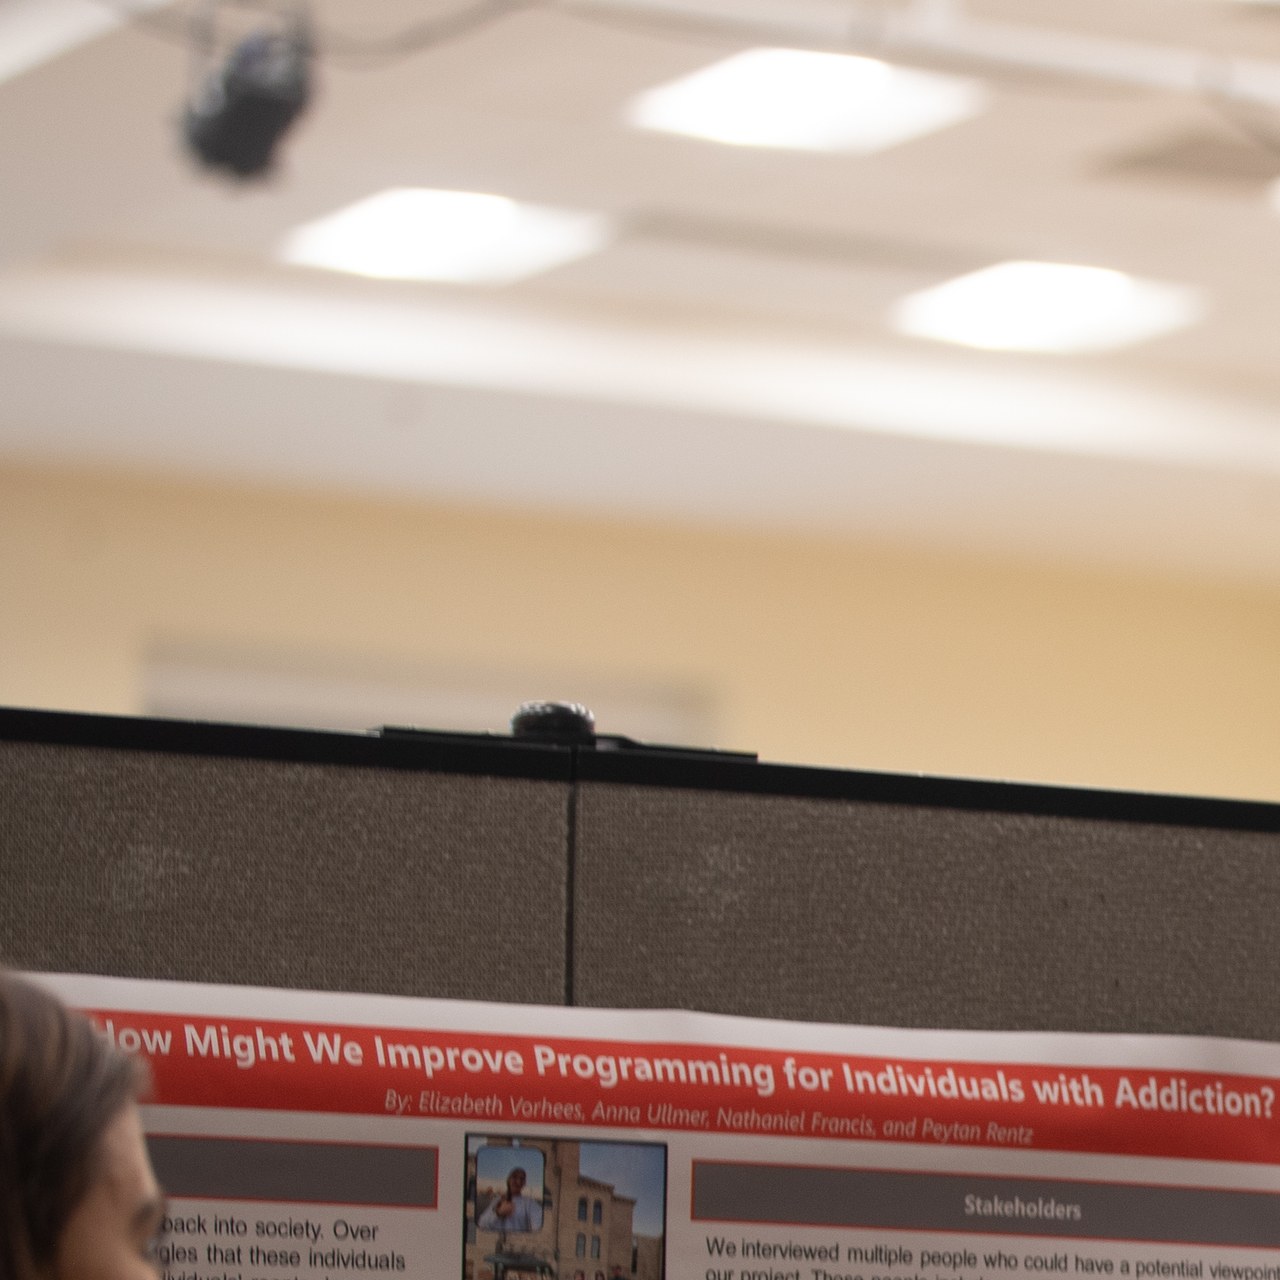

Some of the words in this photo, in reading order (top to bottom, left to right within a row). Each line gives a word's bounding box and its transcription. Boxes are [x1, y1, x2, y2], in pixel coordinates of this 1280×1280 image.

[183, 1023, 296, 1069] Might
[302, 1030, 364, 1067] We
[373, 1035, 524, 1076] Improve
[537, 1044, 776, 1097] Programming
[782, 1056, 834, 1091] for
[841, 1062, 1026, 1102] Individuals
[1031, 1073, 1104, 1106] with
[1114, 1076, 1275, 1117] Addiction?
[418, 1090, 503, 1115] Elizabeth
[591, 1099, 641, 1123] Anna
[646, 1102, 710, 1128] Ullmer,
[716, 1106, 806, 1131] Nathaniel
[810, 1111, 876, 1136] Francis,
[882, 1116, 917, 1137] and
[985, 1121, 1034, 1143] Rentz
[964, 1194, 1082, 1220] Stakeholders
[213, 1214, 248, 1236] into
[255, 1217, 324, 1244] society.
[332, 1219, 379, 1241] Over
[206, 1243, 242, 1265] that
[248, 1245, 301, 1266] these
[308, 1247, 406, 1270] individuals
[705, 1236, 737, 1257] We
[740, 1238, 840, 1262] interviewed
[846, 1244, 913, 1268] multiple
[919, 1248, 978, 1271] people
[982, 1250, 1019, 1270] who
[1023, 1253, 1068, 1272] could
[1074, 1254, 1114, 1274] have
[1119, 1260, 1131, 1275] a
[1135, 1259, 1203, 1280] potential
